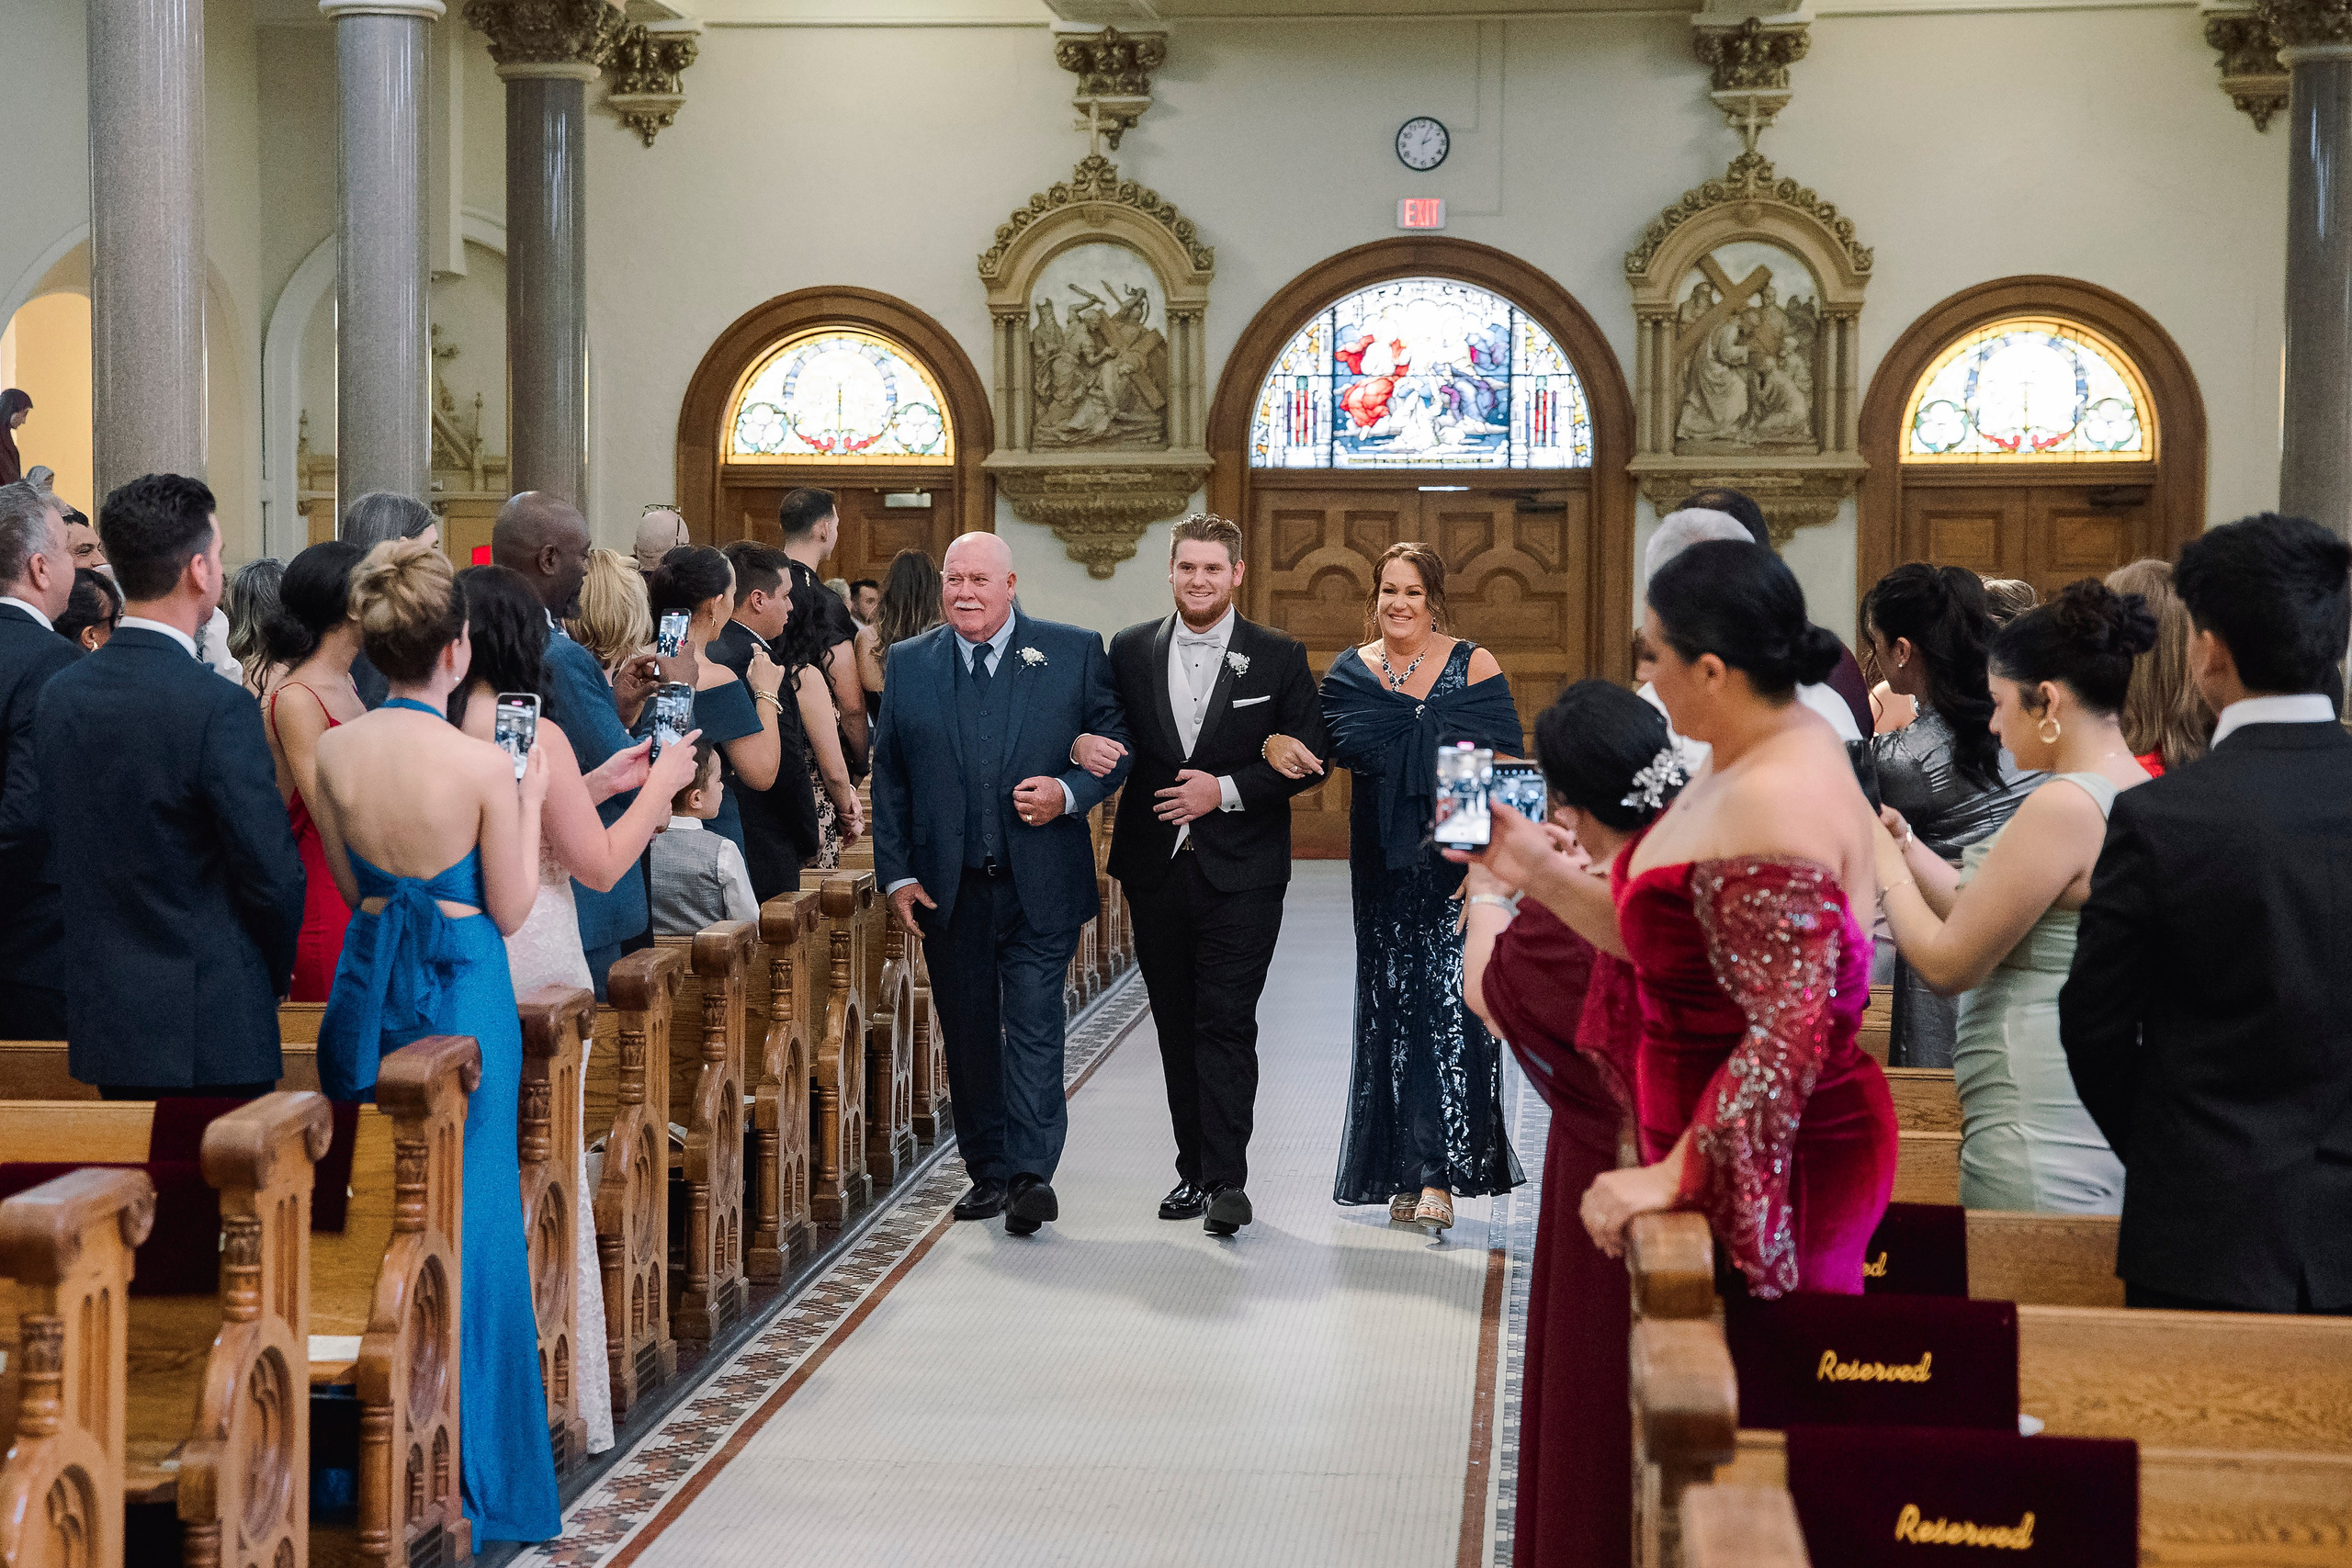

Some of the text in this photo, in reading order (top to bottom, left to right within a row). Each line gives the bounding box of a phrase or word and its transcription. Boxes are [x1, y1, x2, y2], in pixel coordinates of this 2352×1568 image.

[1404, 198, 1440, 227] EXIT
[1817, 1349, 1931, 1382] Reserved
[1894, 1504, 2035, 1550] Reserved
